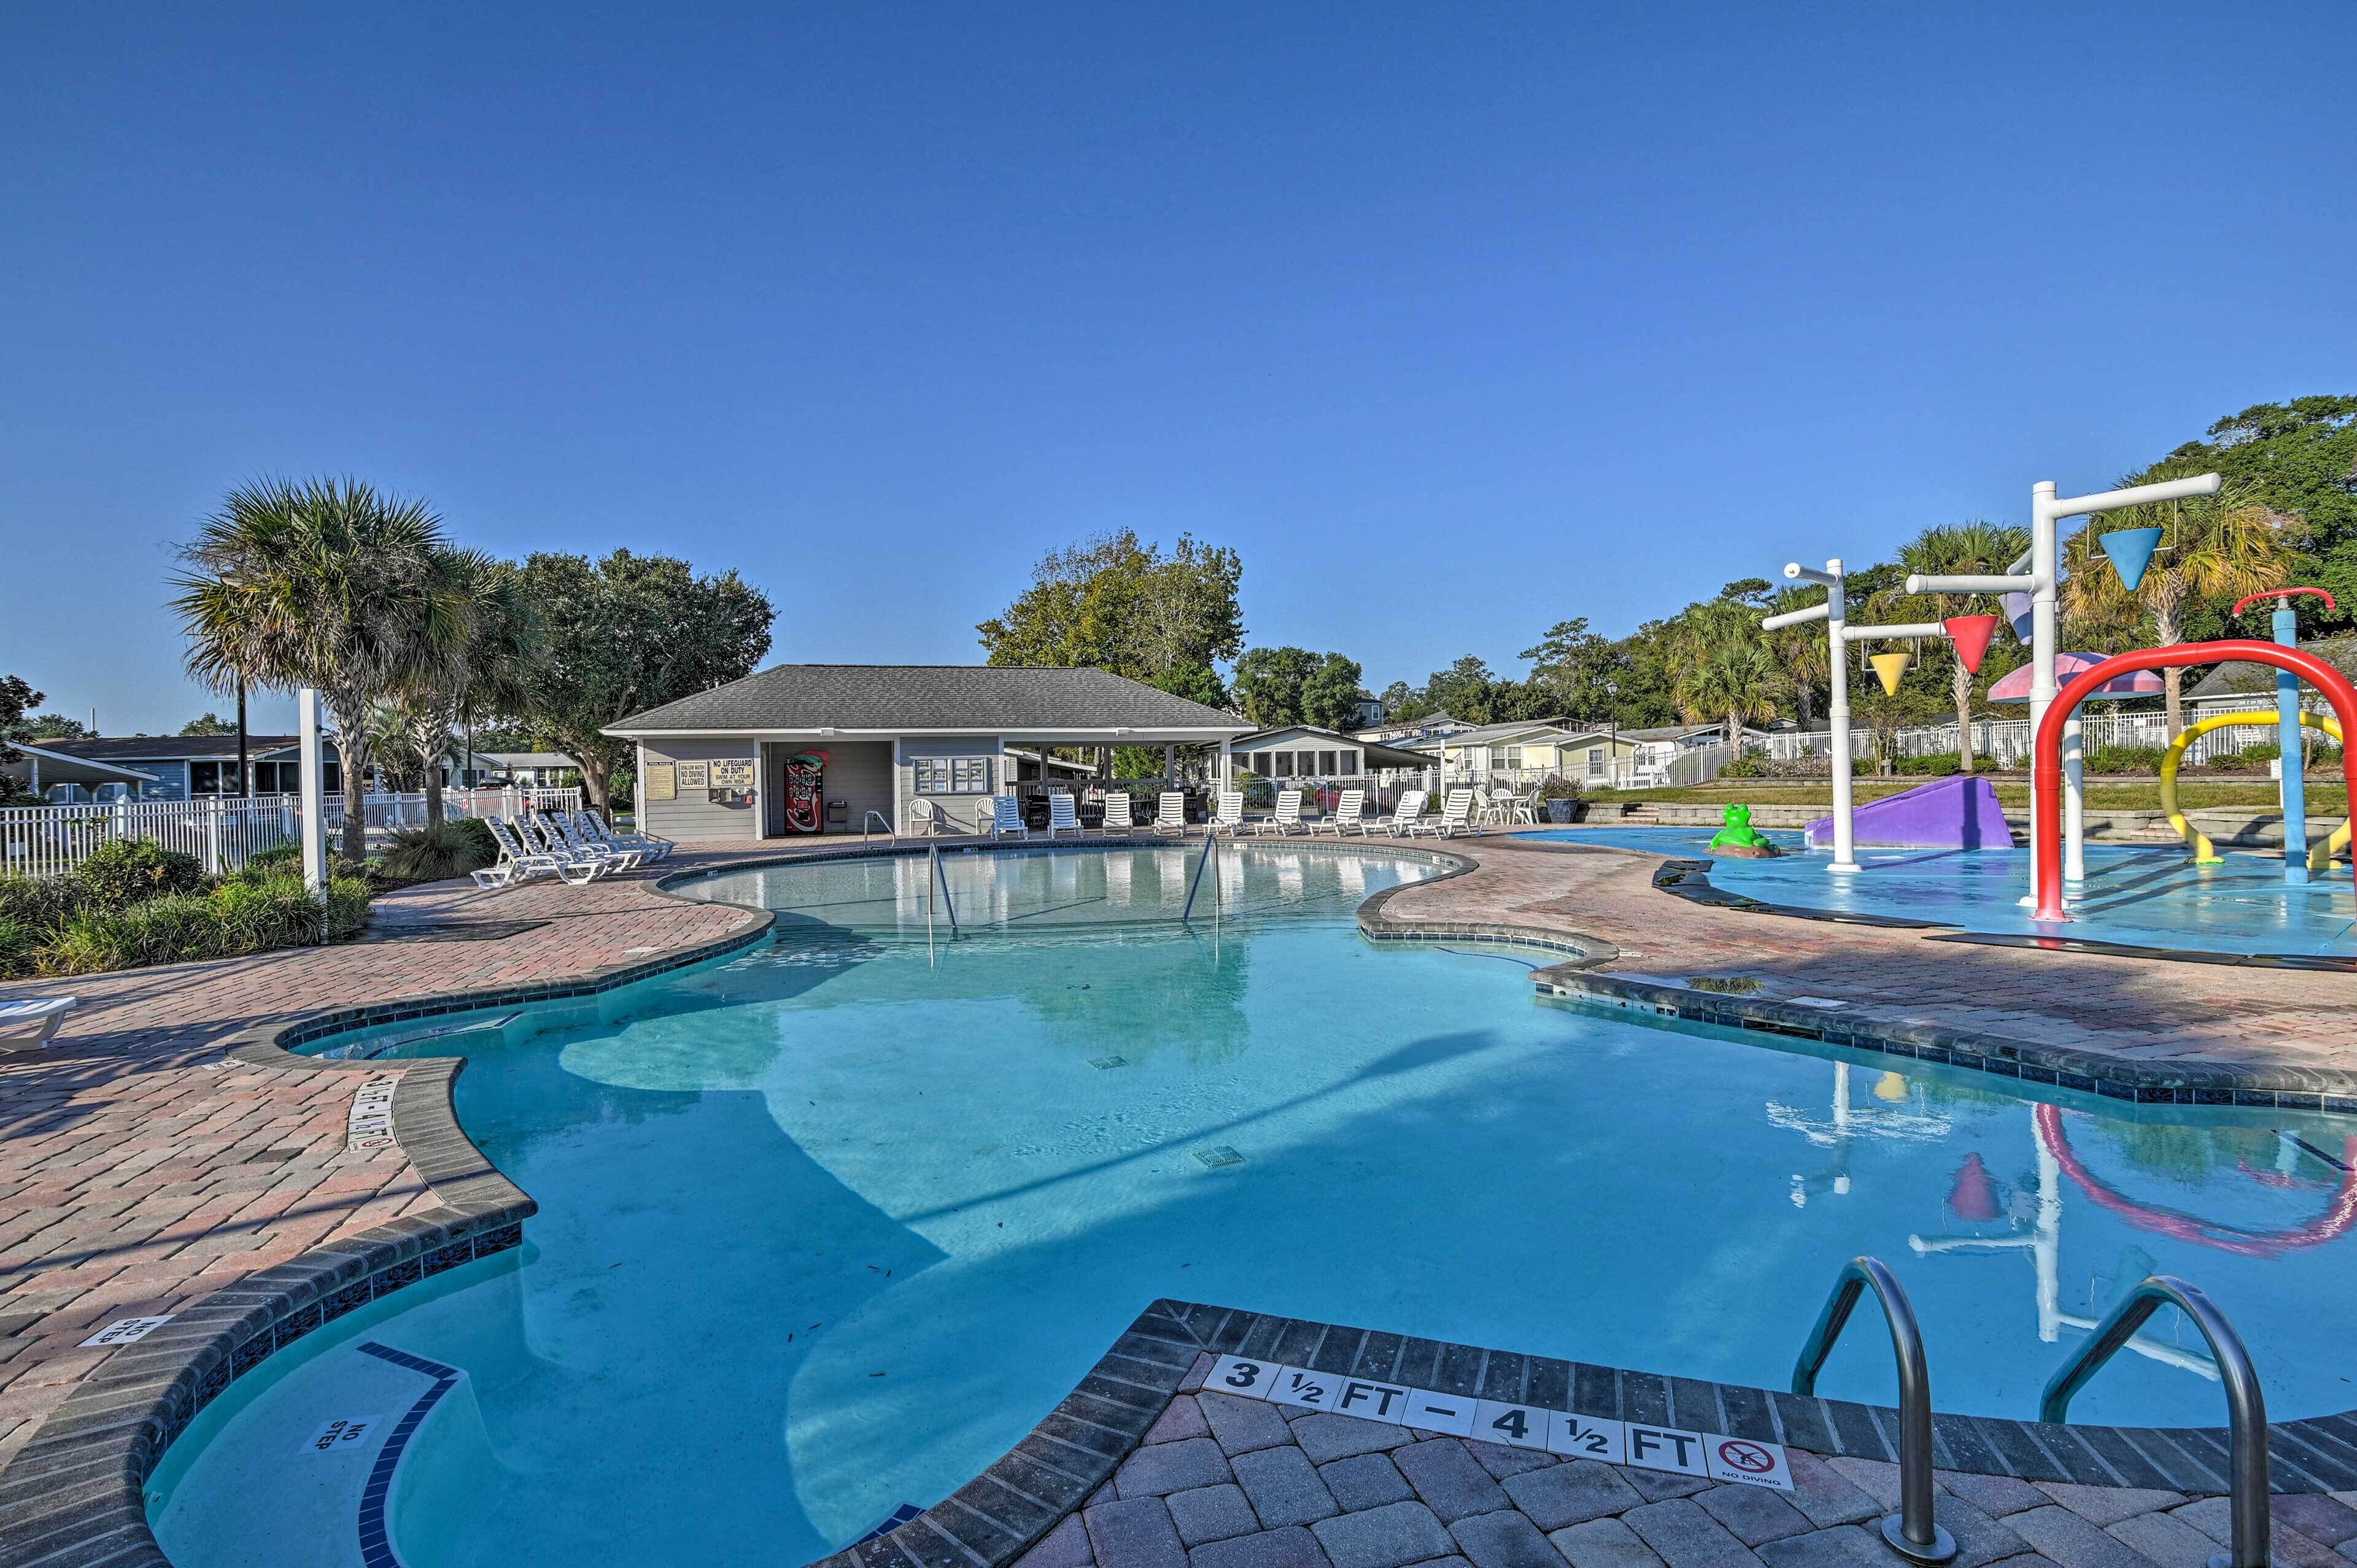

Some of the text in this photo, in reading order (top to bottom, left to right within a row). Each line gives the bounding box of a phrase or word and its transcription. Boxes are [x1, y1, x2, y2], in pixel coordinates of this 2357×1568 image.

[358, 1095, 388, 1104] FT
[355, 1128, 388, 1140] FT
[97, 1319, 141, 1343] STEP
[125, 1321, 157, 1336] NO
[1225, 1363, 1260, 1387] 3
[1341, 1381, 1404, 1416] FT
[1492, 1409, 1528, 1439] 4
[1632, 1428, 1697, 1467] FT
[314, 1420, 348, 1449] STEP
[342, 1423, 367, 1440] NO
[1743, 1475, 1781, 1486] DIVING
